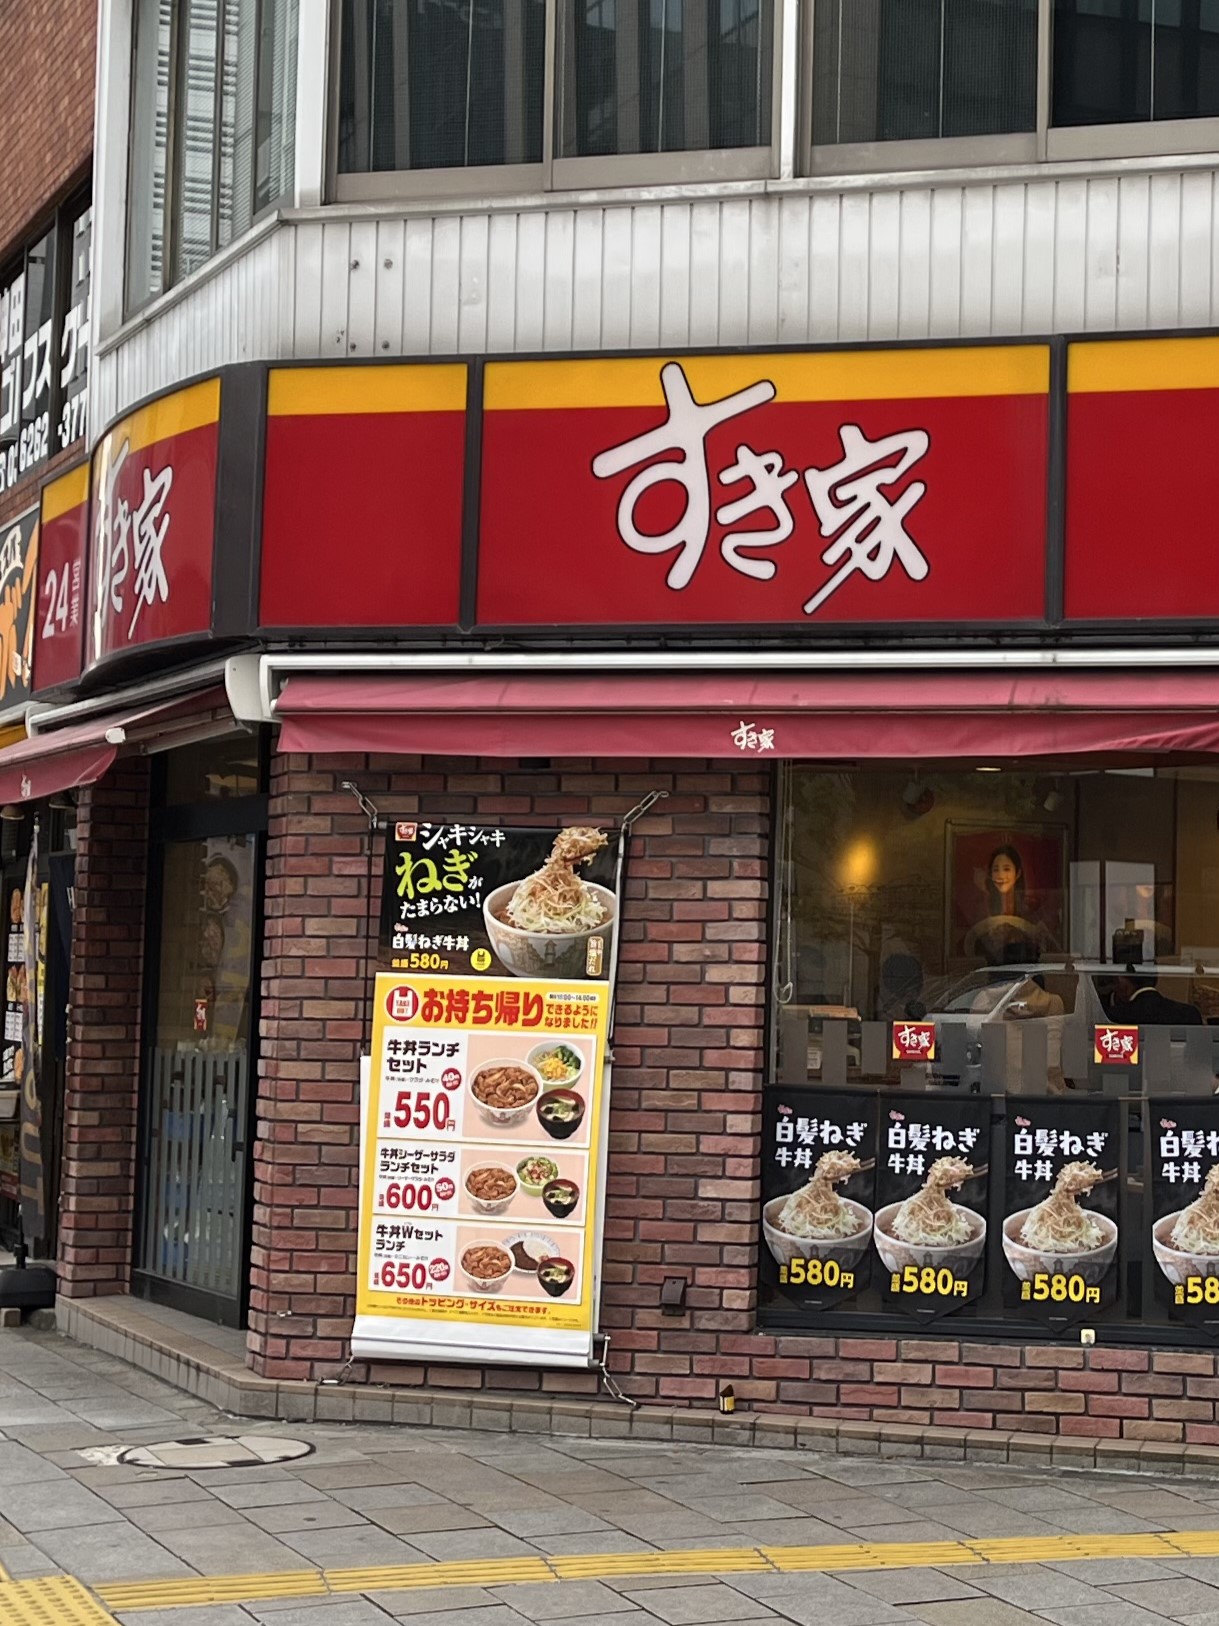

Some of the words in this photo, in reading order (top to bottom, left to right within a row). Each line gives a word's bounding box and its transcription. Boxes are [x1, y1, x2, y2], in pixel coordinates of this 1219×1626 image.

[592, 361, 931, 616] すき家
[42, 562, 69, 640] 24
[730, 720, 775, 753] すき家
[419, 822, 506, 851] シャキシャキ
[395, 848, 484, 900] ねぎが
[399, 891, 482, 920] たまらない!
[392, 932, 470, 952] 白髪ねぎ牛丼
[409, 952, 449, 970] 580円
[421, 987, 544, 1027] お持ち帰り
[545, 1002, 599, 1017] できるように
[386, 1038, 461, 1057] 牛丼ランチ
[897, 1024, 932, 1050] すき家
[1100, 1028, 1134, 1054] すき家
[386, 1057, 428, 1074] セット
[393, 1090, 456, 1132] 550円
[775, 1116, 868, 1147] 白髪ねぎ
[887, 1122, 980, 1152] 白髪ねぎ
[1013, 1127, 1109, 1158] 白髪ねぎ
[379, 1160, 439, 1175] ランチセット
[380, 1147, 456, 1163] 牛丼シーザーサラダ
[774, 1147, 813, 1169] 牛丼
[887, 1153, 925, 1176] 牛丼
[1014, 1159, 1053, 1182] 牛丼
[1161, 1160, 1202, 1184] 牛丼
[386, 1182, 440, 1212] 600円
[375, 1223, 444, 1241] 牛丼Wセット
[375, 1239, 406, 1252] ランチ
[381, 1260, 434, 1291] 650円
[789, 1257, 855, 1289] 580円
[902, 1265, 968, 1297] 580円
[1033, 1272, 1100, 1303] 580円
